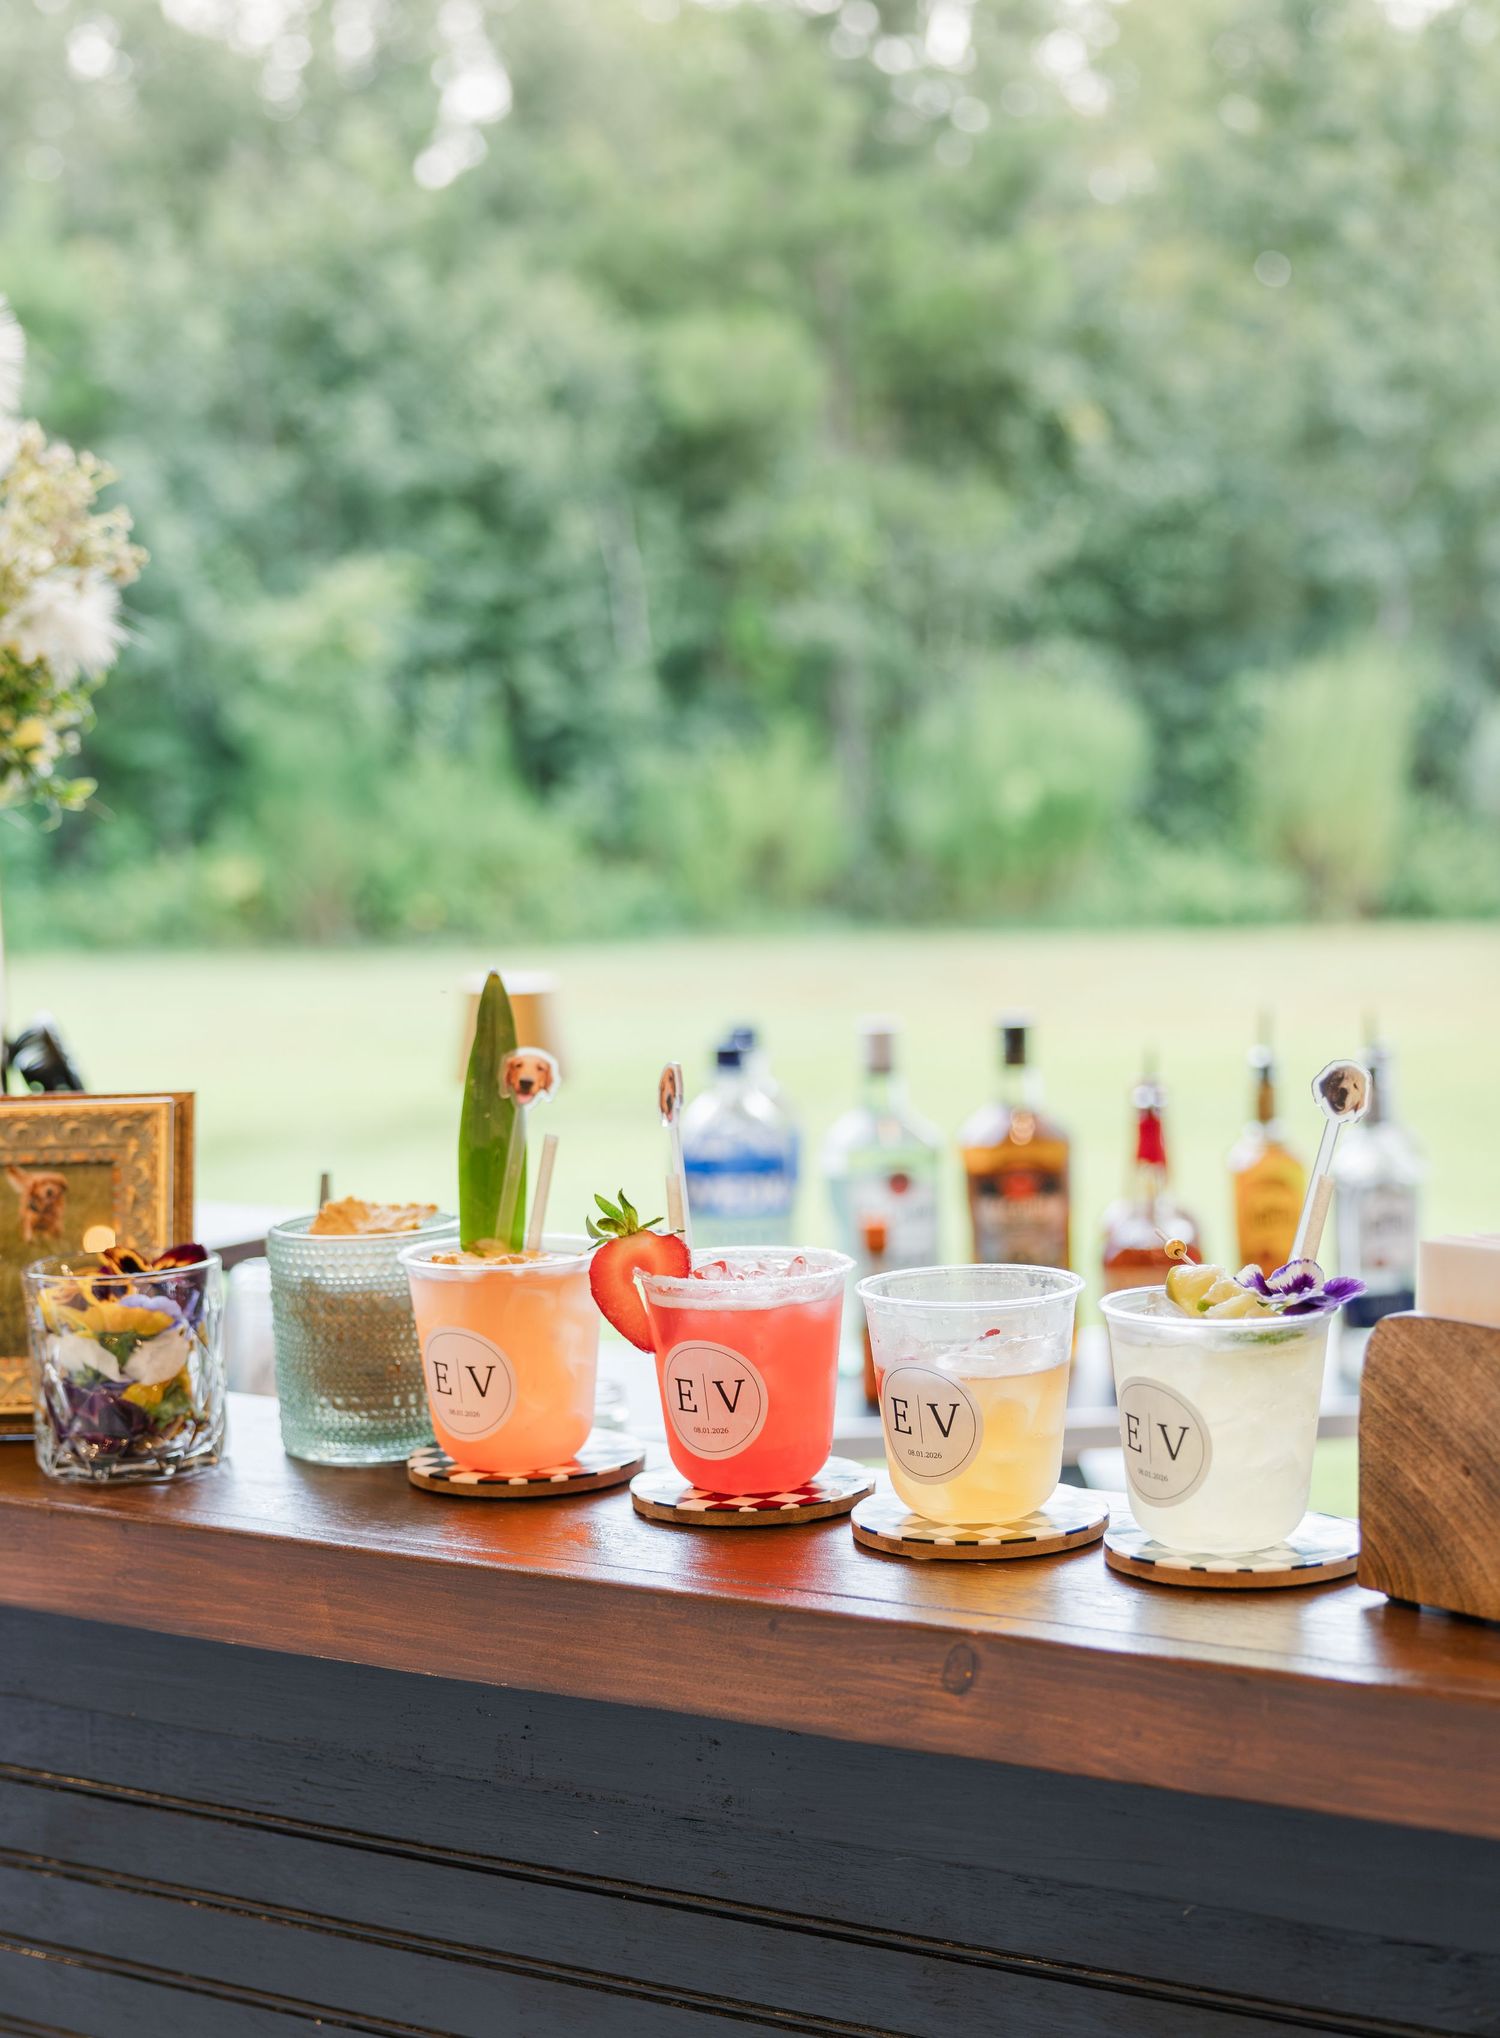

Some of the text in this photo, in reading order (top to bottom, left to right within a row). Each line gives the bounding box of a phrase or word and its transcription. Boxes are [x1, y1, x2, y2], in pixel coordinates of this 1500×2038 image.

[433, 1360, 496, 1398] E V
[674, 1378, 745, 1414] E V
[693, 1426, 729, 1435] 08.01.2026
[890, 1396, 960, 1438] E V
[907, 1449, 943, 1459] 08.01.2026
[1125, 1412, 1189, 1461] E V
